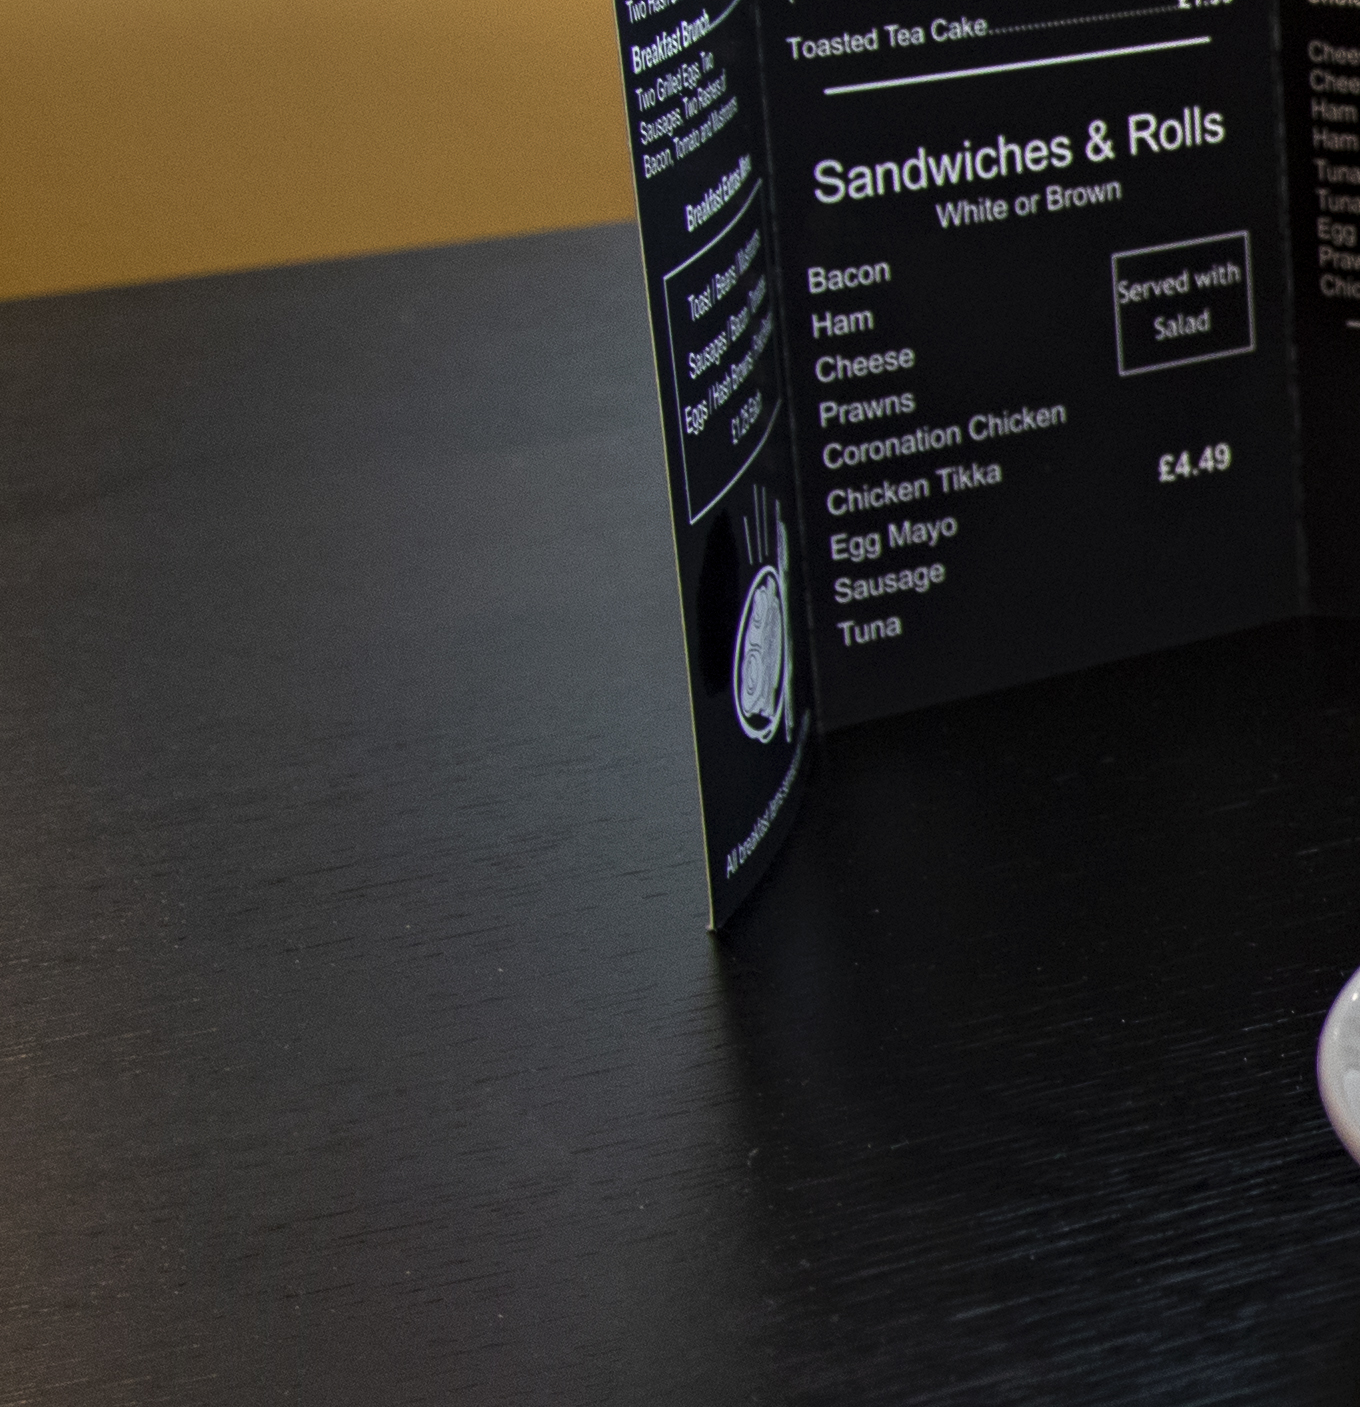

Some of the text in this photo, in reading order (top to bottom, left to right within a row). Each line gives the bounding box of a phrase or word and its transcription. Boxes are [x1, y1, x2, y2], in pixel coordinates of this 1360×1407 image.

[631, 25, 682, 75] Breakfast
[785, 27, 879, 60] Toasted
[883, 23, 926, 47] Tea
[929, 16, 988, 43] Cake
[812, 105, 1226, 204] Sandwiches & Rolls
[934, 180, 1122, 229] White or Brown
[806, 261, 891, 295] Bacon
[1118, 263, 1241, 305] Served with
[811, 309, 874, 339] Ham
[1153, 308, 1211, 341] Salad
[814, 347, 916, 383] Cheese
[818, 392, 916, 428] Prawns
[821, 404, 1067, 470] Coronation Chicken
[1157, 442, 1232, 483] £4.49
[825, 463, 1003, 516] Chicken Tikka
[829, 516, 958, 562] Egg Mayo
[833, 563, 946, 604] Sausage
[836, 616, 902, 647] Tuna
